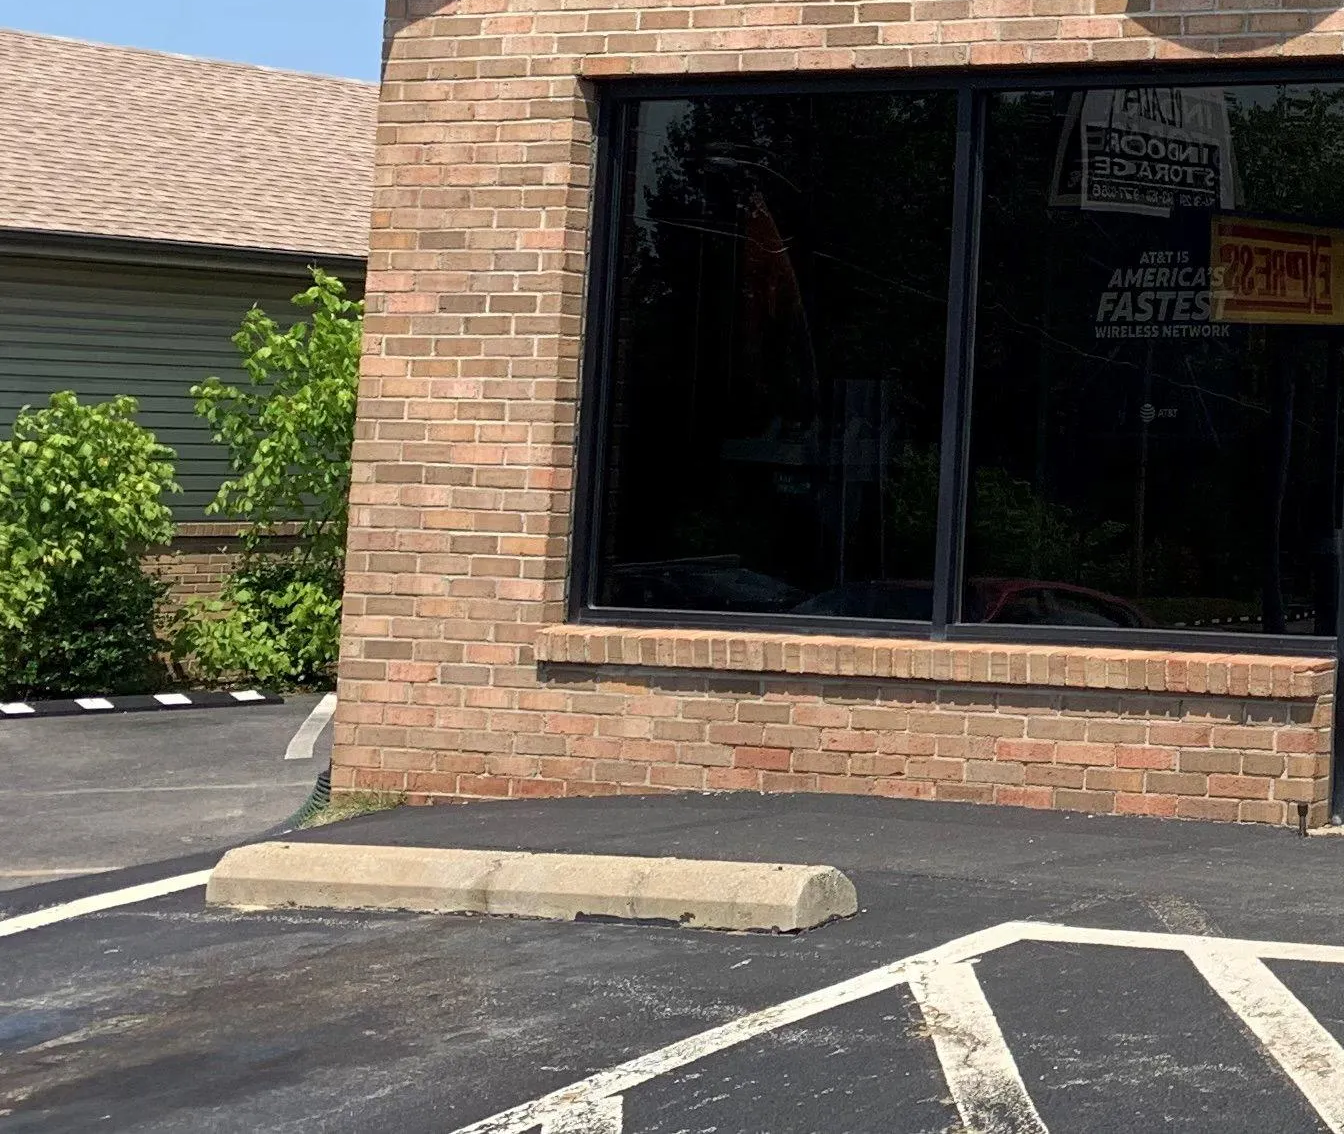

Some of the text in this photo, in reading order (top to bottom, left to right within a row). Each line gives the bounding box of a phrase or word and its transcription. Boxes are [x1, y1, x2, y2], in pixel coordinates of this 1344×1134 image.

[1140, 250, 1190, 265] AT&T IS
[1107, 266, 1226, 289] AMERICA'S
[1095, 290, 1235, 322] FASTEST
[1094, 324, 1231, 339] WIRELESS NETWORK
[1157, 408, 1180, 419] AT&T
